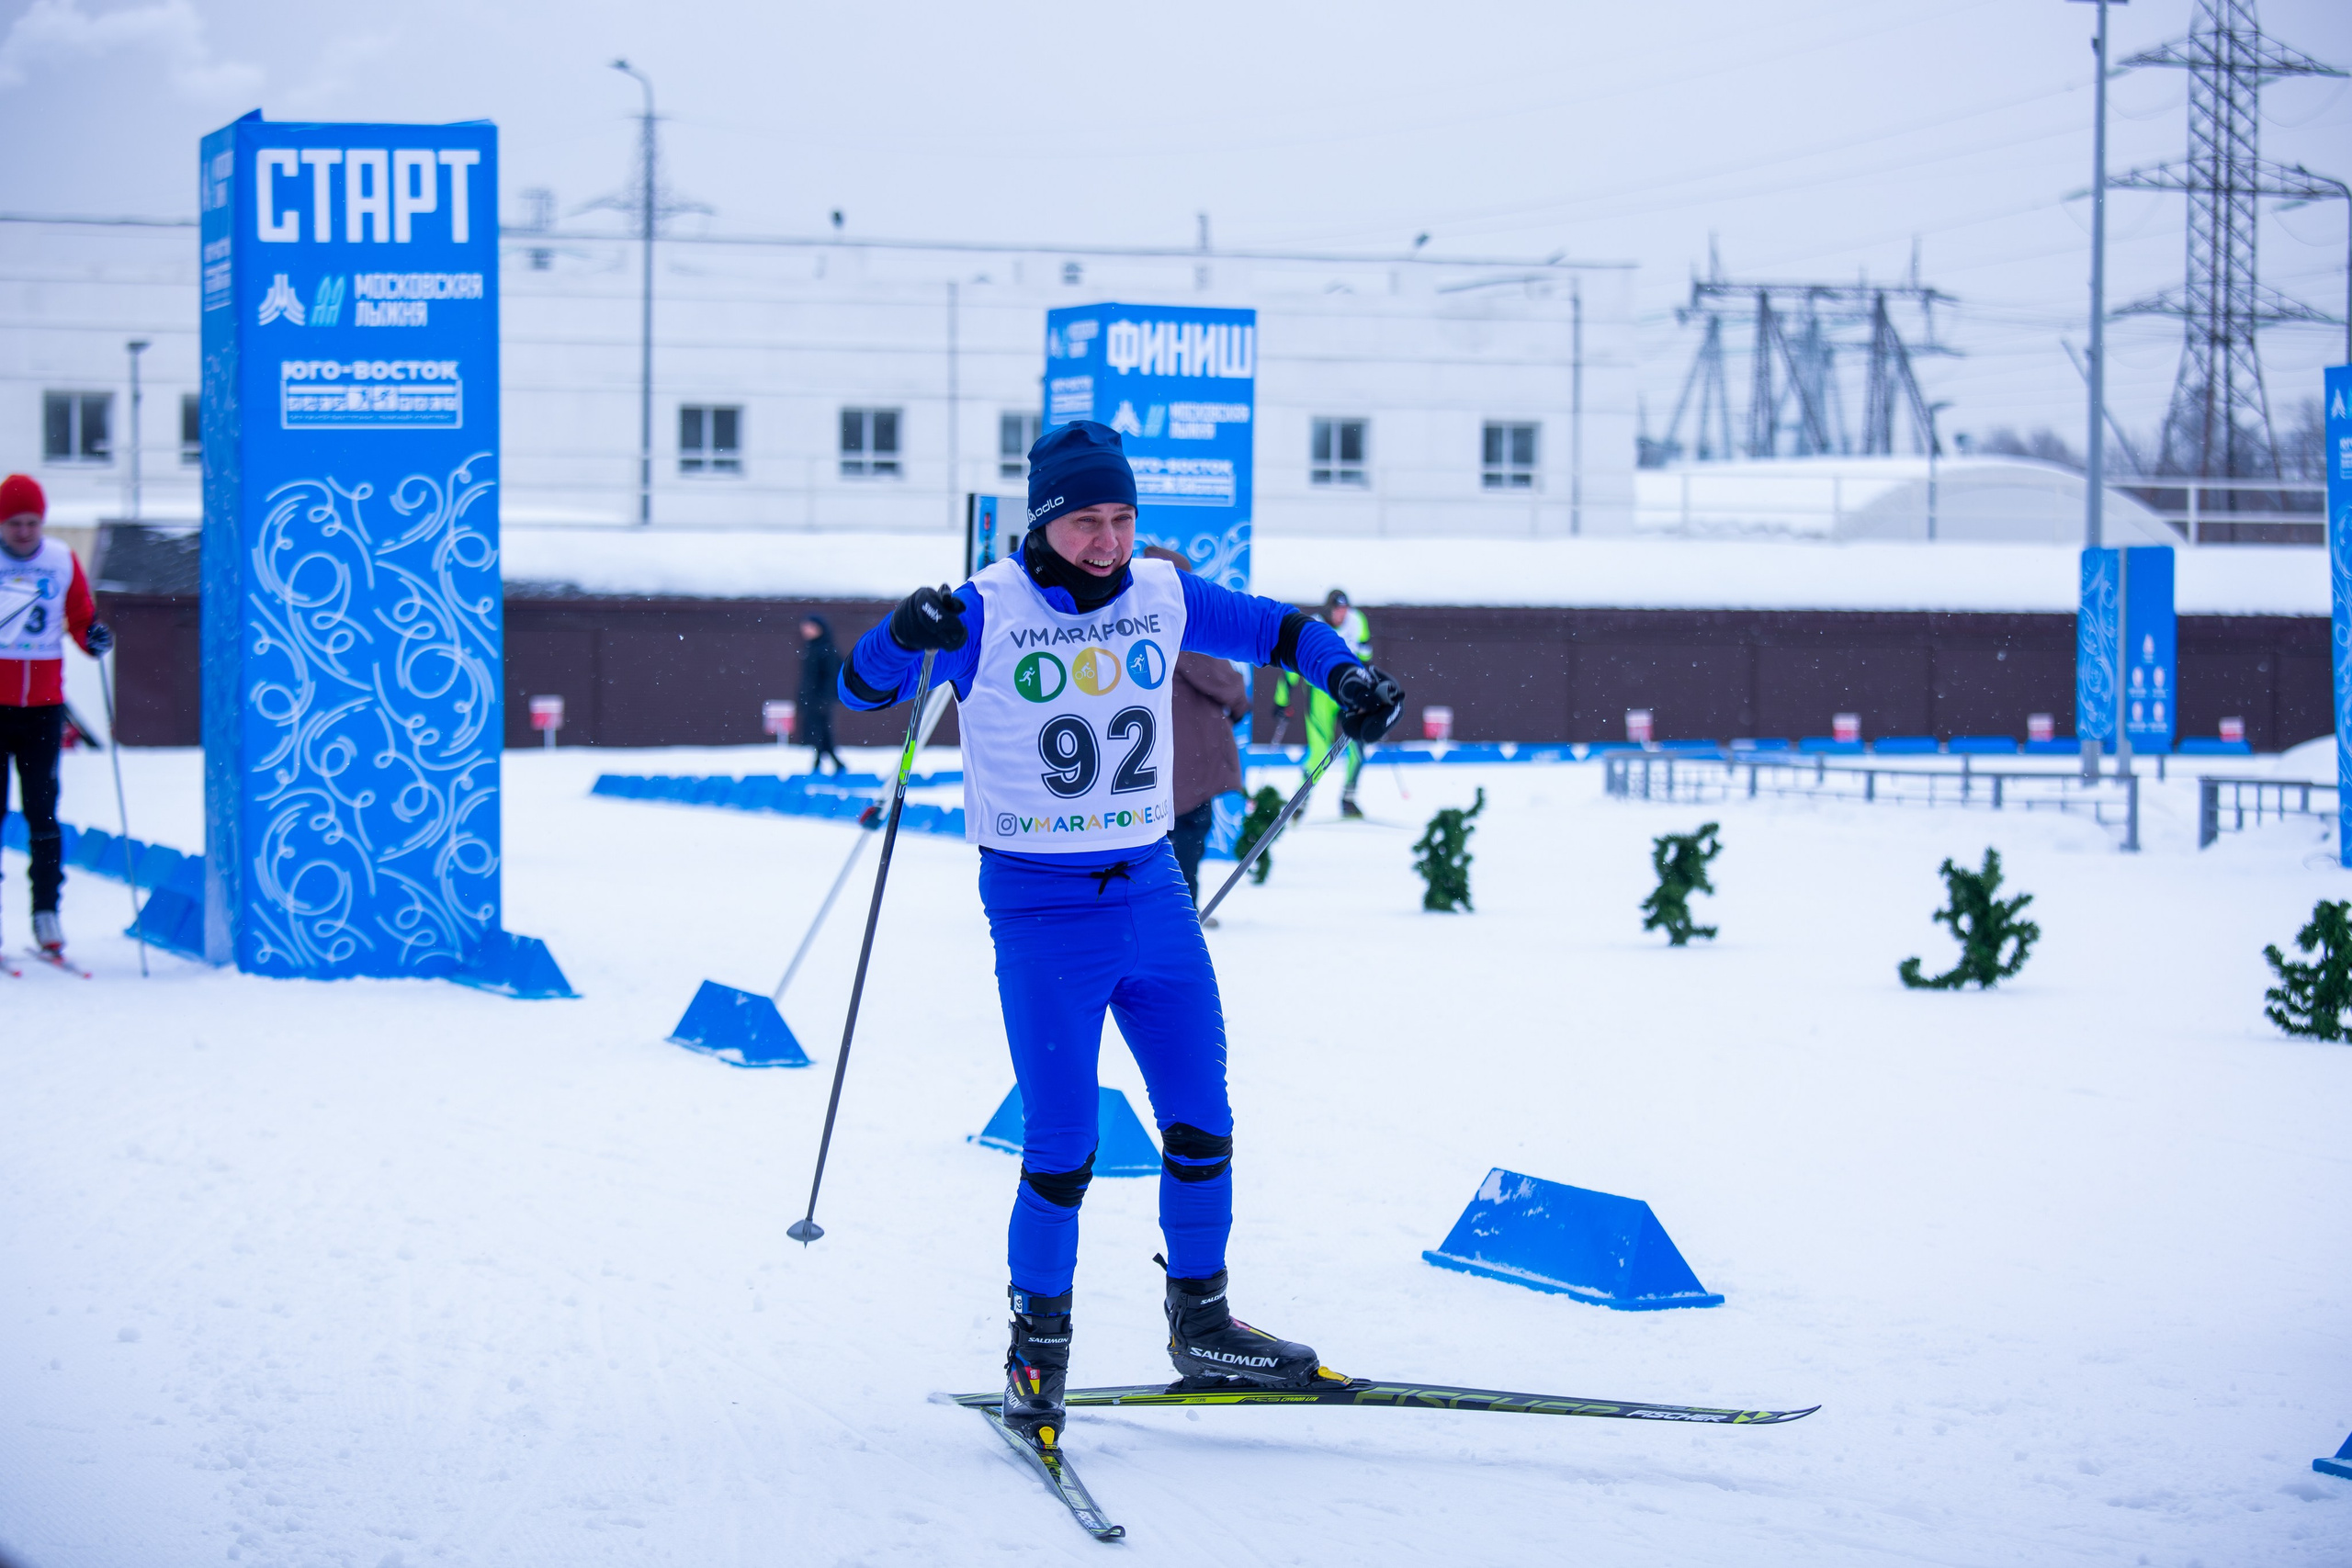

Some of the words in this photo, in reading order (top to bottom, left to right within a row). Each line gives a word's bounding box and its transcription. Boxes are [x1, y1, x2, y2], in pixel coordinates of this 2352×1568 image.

[255, 148, 481, 243] СТАРТ
[354, 273, 483, 299] МОСКОВСКАЯ
[355, 300, 428, 327] ЛЫЖНЯ
[1106, 319, 1254, 379] ФИНИШ
[280, 360, 460, 380] ЮГО-ВОСТОК
[1035, 496, 1065, 517] odlo
[1010, 614, 1161, 649] VMARAFONE
[1038, 705, 1158, 799] 92
[1189, 1347, 1279, 1368] SALOMON
[1626, 1409, 1728, 1423] FISCHER
